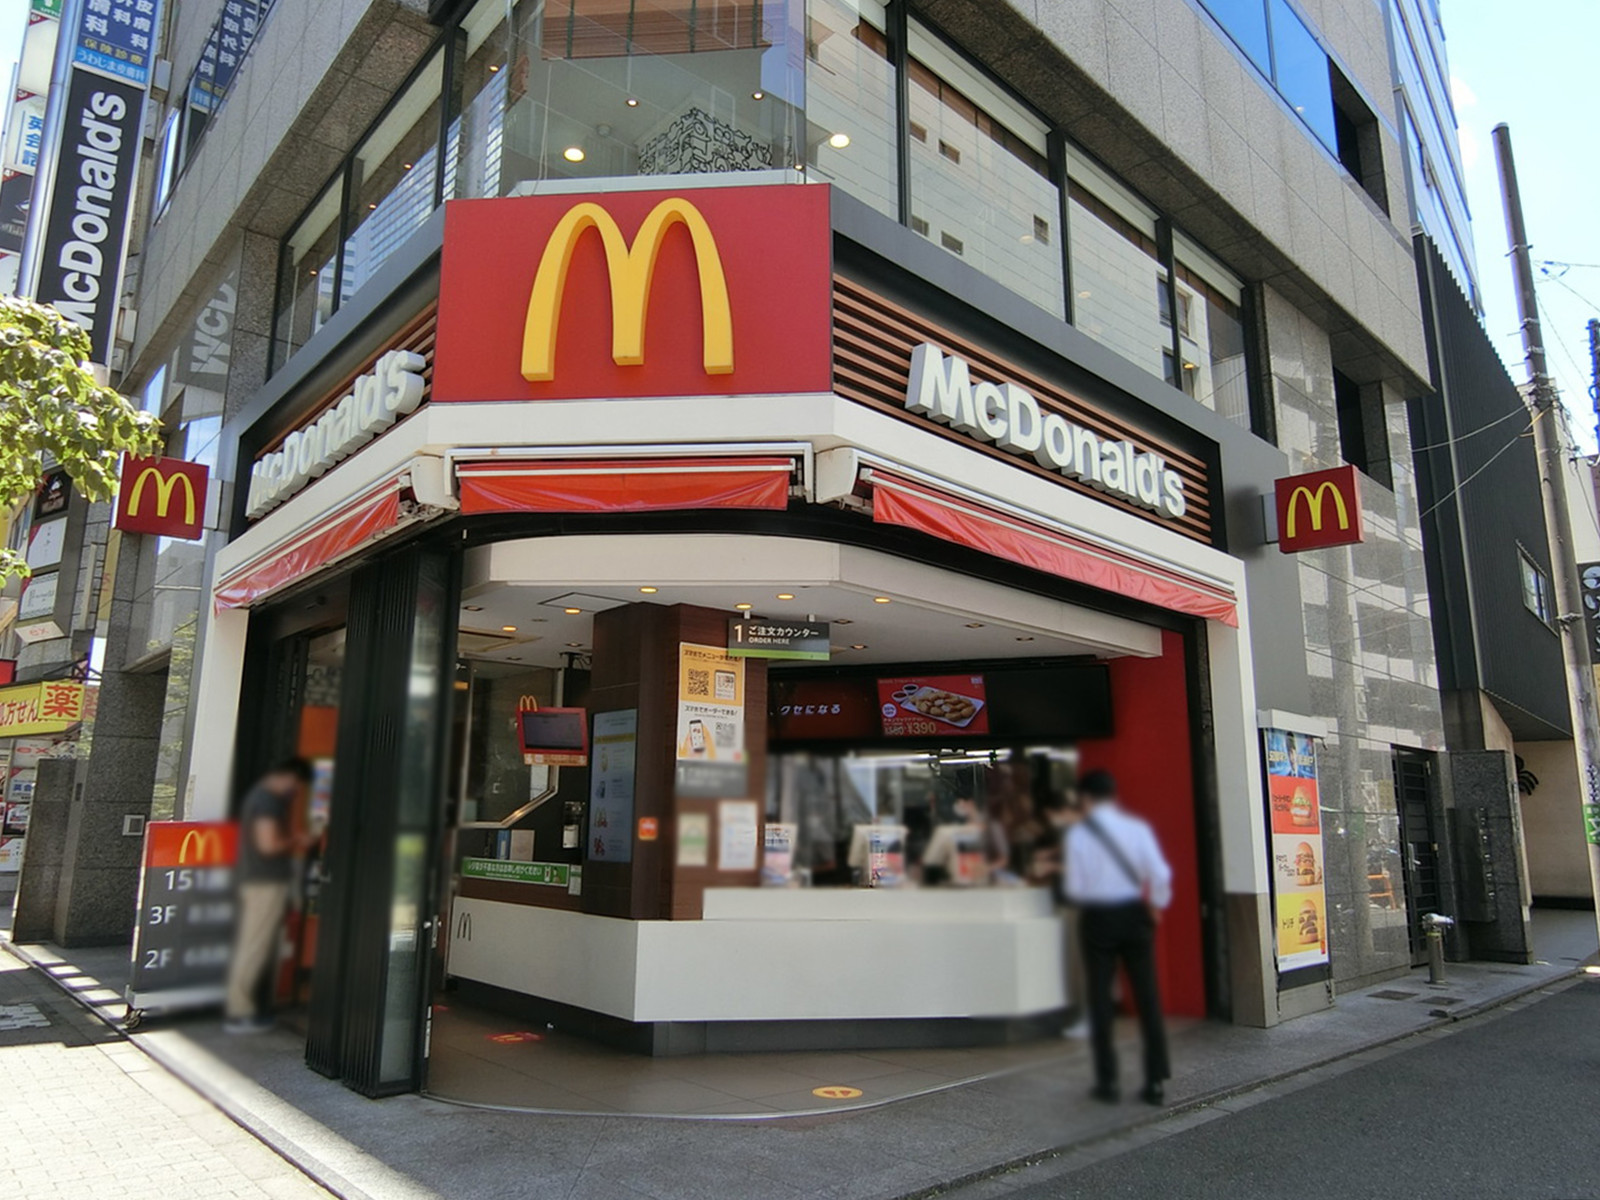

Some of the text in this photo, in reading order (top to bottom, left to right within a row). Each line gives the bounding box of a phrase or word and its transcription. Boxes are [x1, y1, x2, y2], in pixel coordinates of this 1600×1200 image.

[78, 49, 145, 81] うわじま皮膚科
[85, 38, 143, 65] 保険診療
[53, 92, 127, 333] McDonald's
[245, 350, 427, 519] McDonald's
[905, 342, 1187, 519] McDonald's
[734, 624, 820, 643] 1 ご注文カウンター
[43, 685, 81, 719] 薬
[149, 904, 177, 925] 3F
[144, 949, 172, 969] 2F
